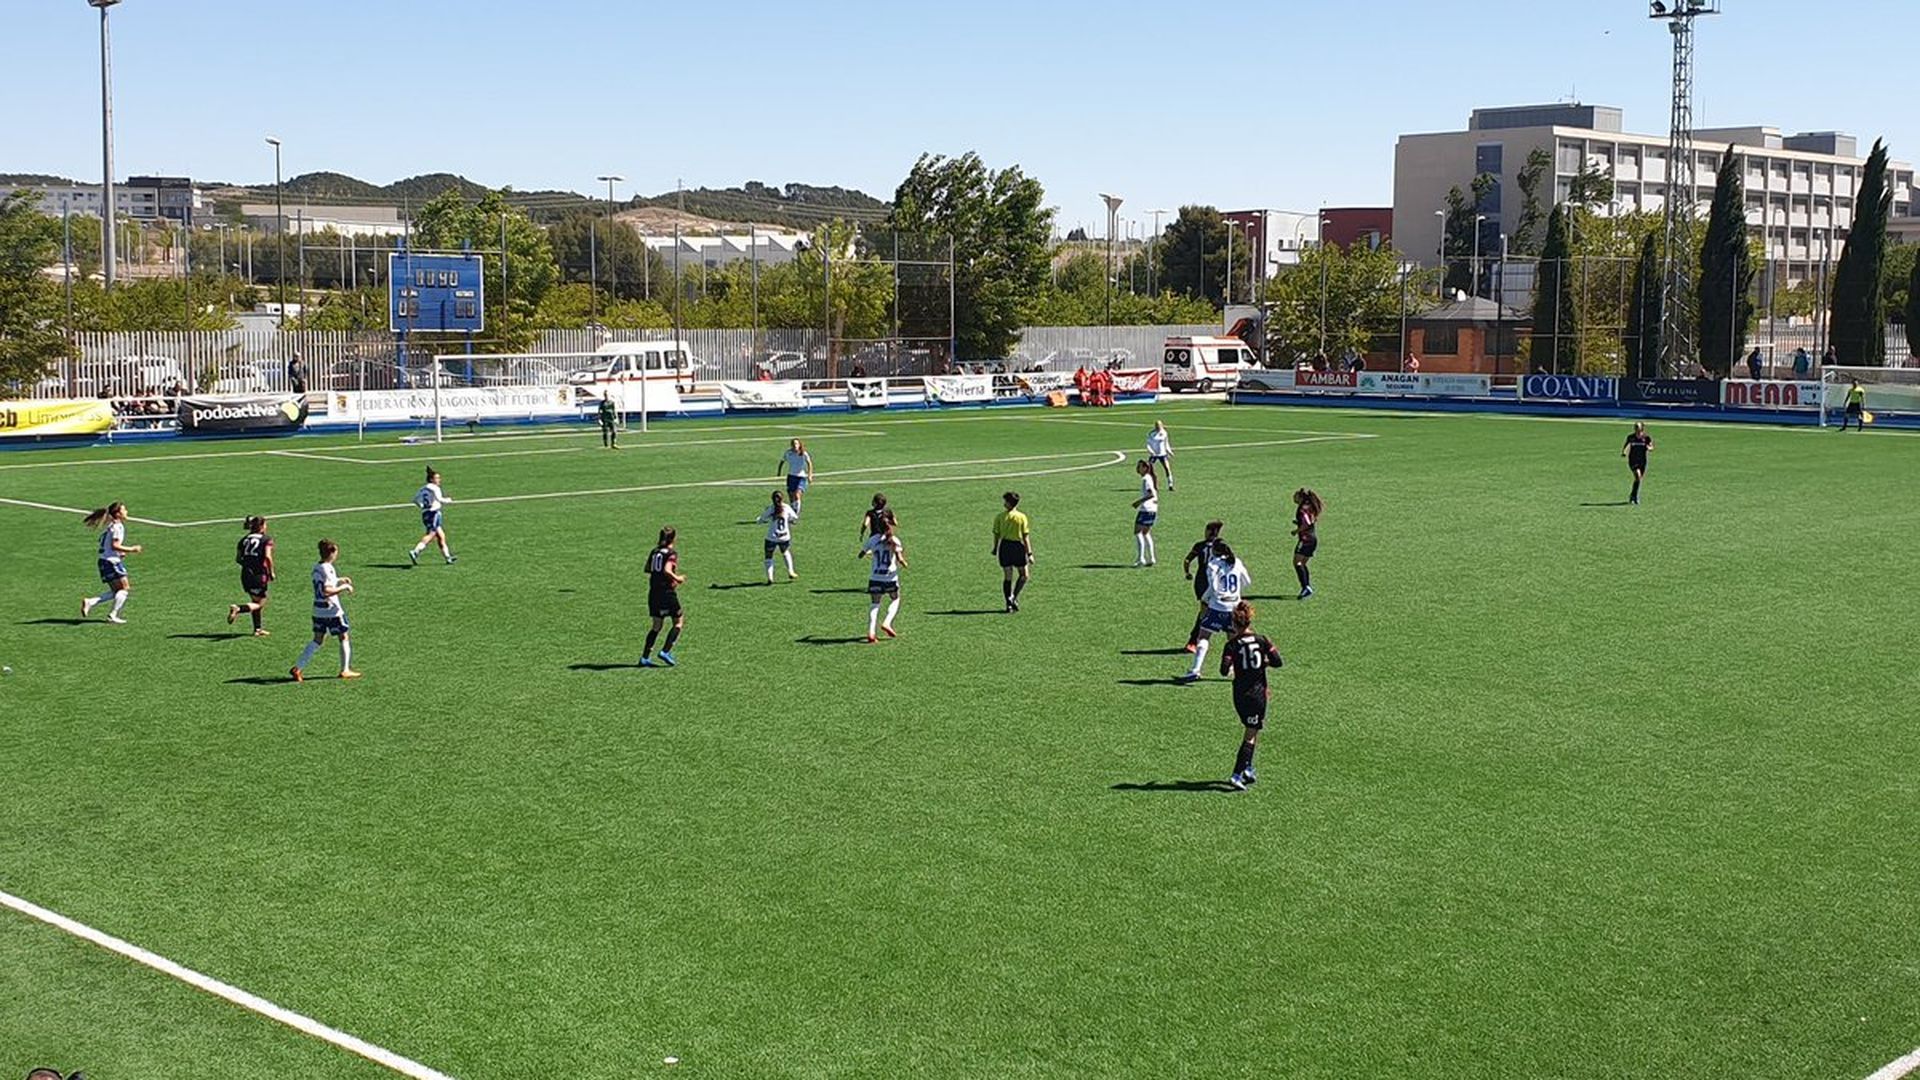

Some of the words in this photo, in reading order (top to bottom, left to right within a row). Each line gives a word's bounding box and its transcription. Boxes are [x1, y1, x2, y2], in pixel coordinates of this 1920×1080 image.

[1310, 373, 1350, 386] AMBAR
[1381, 375, 1420, 383] ANAGAN
[1527, 376, 1613, 397] COANFI
[193, 403, 276, 427] podoactiva
[242, 538, 260, 557] 22
[1220, 574, 1238, 594] 18
[1239, 642, 1262, 670] 15
